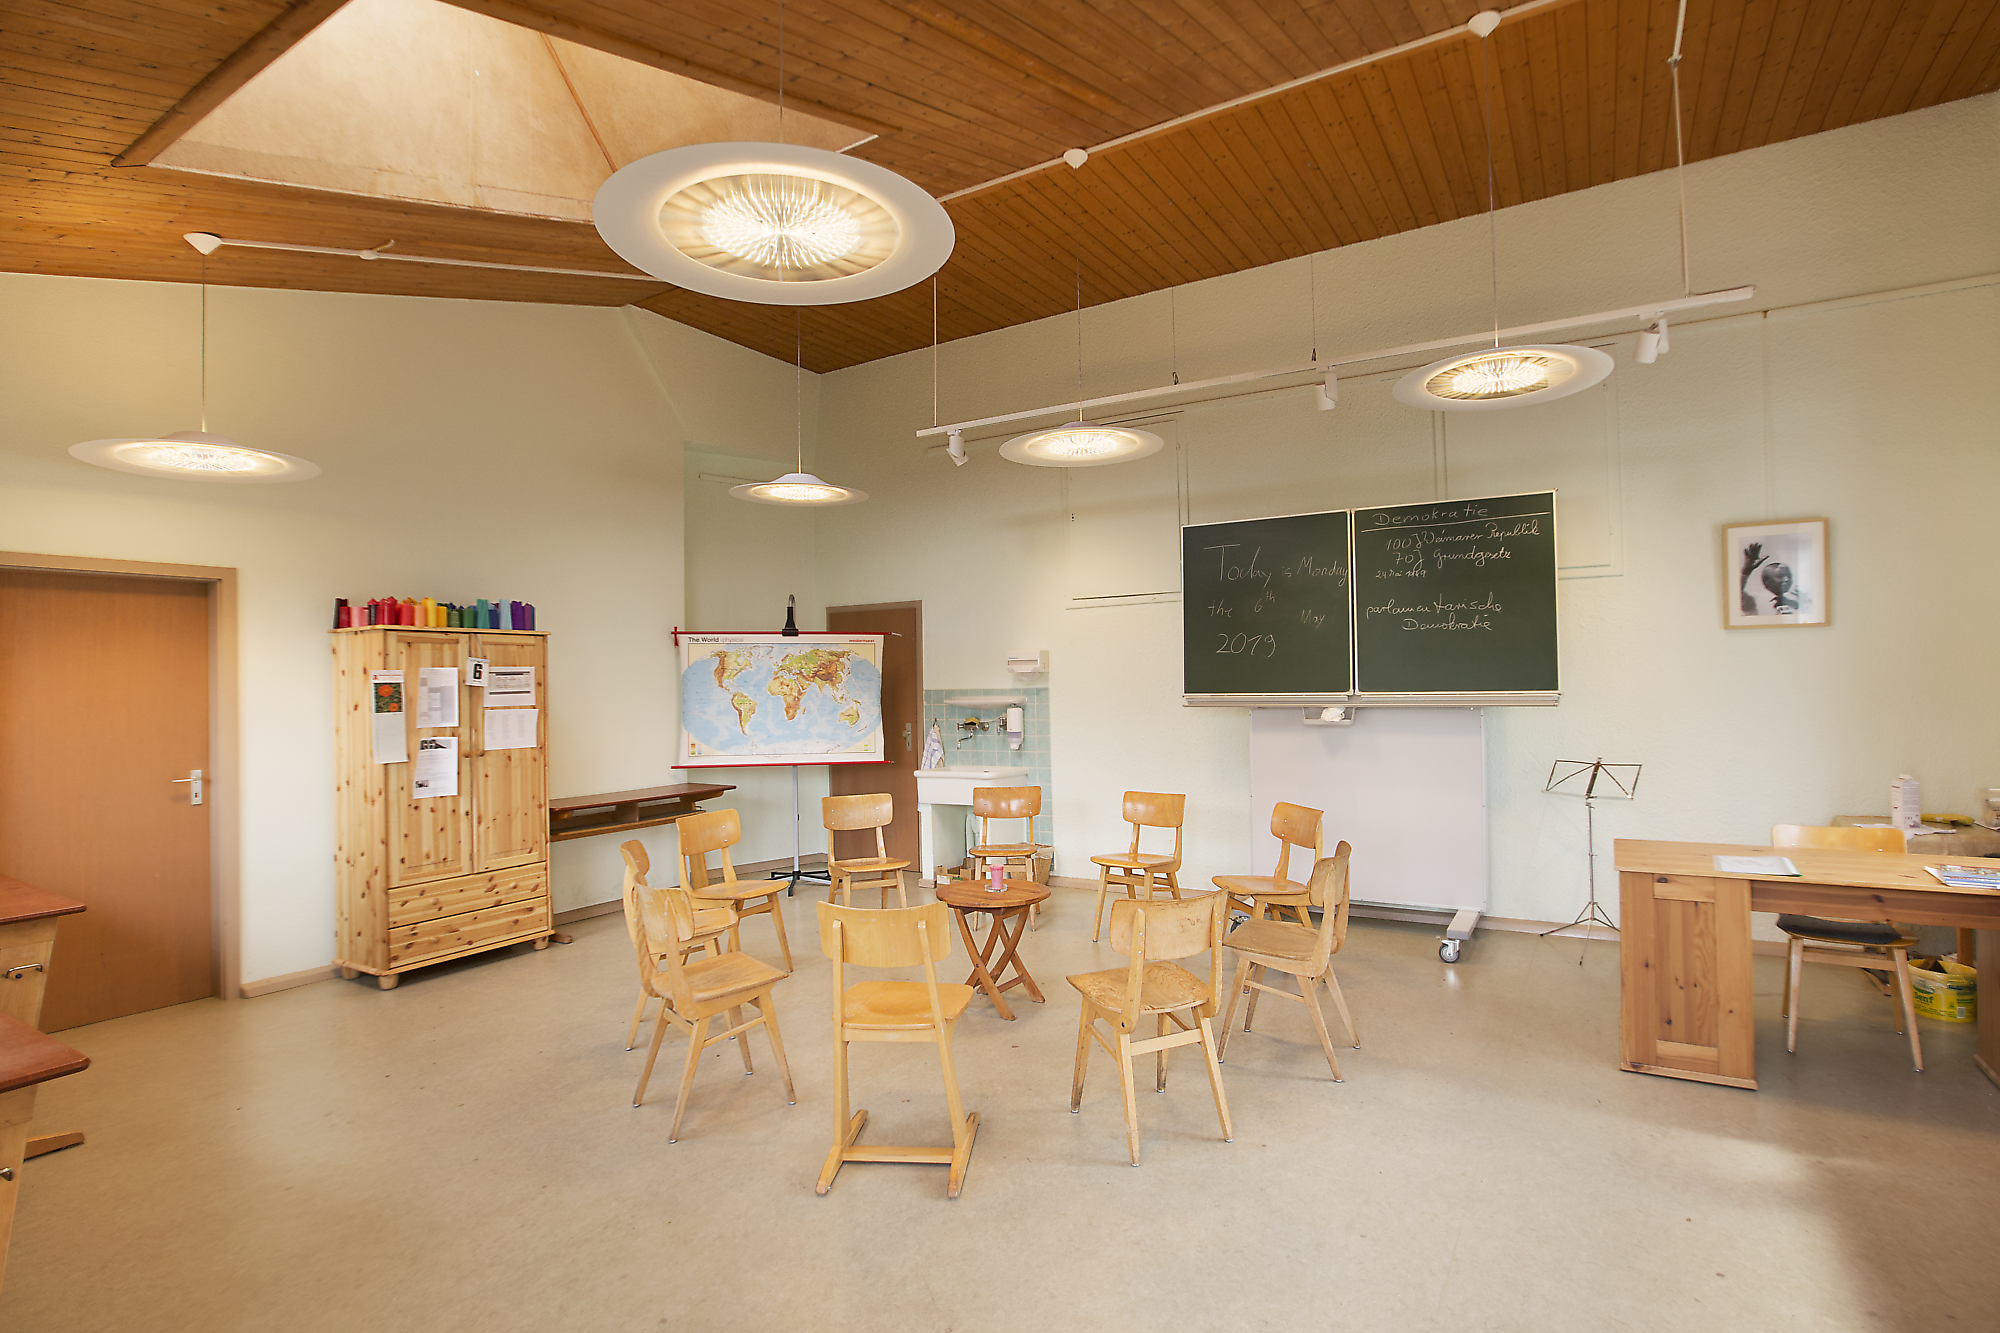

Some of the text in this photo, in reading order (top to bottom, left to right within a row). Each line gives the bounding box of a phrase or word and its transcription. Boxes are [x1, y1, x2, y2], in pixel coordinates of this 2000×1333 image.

[1372, 503, 1488, 526] Demokratie
[1485, 519, 1540, 542] Republik
[1203, 543, 1348, 588] Today is Monday
[1433, 545, 1511, 569] Grundgesetz
[1208, 599, 1233, 618] the
[1301, 609, 1326, 630] May
[1402, 612, 1493, 631] Demokratie
[1215, 632, 1277, 658] 2019
[473, 663, 483, 680] 6
